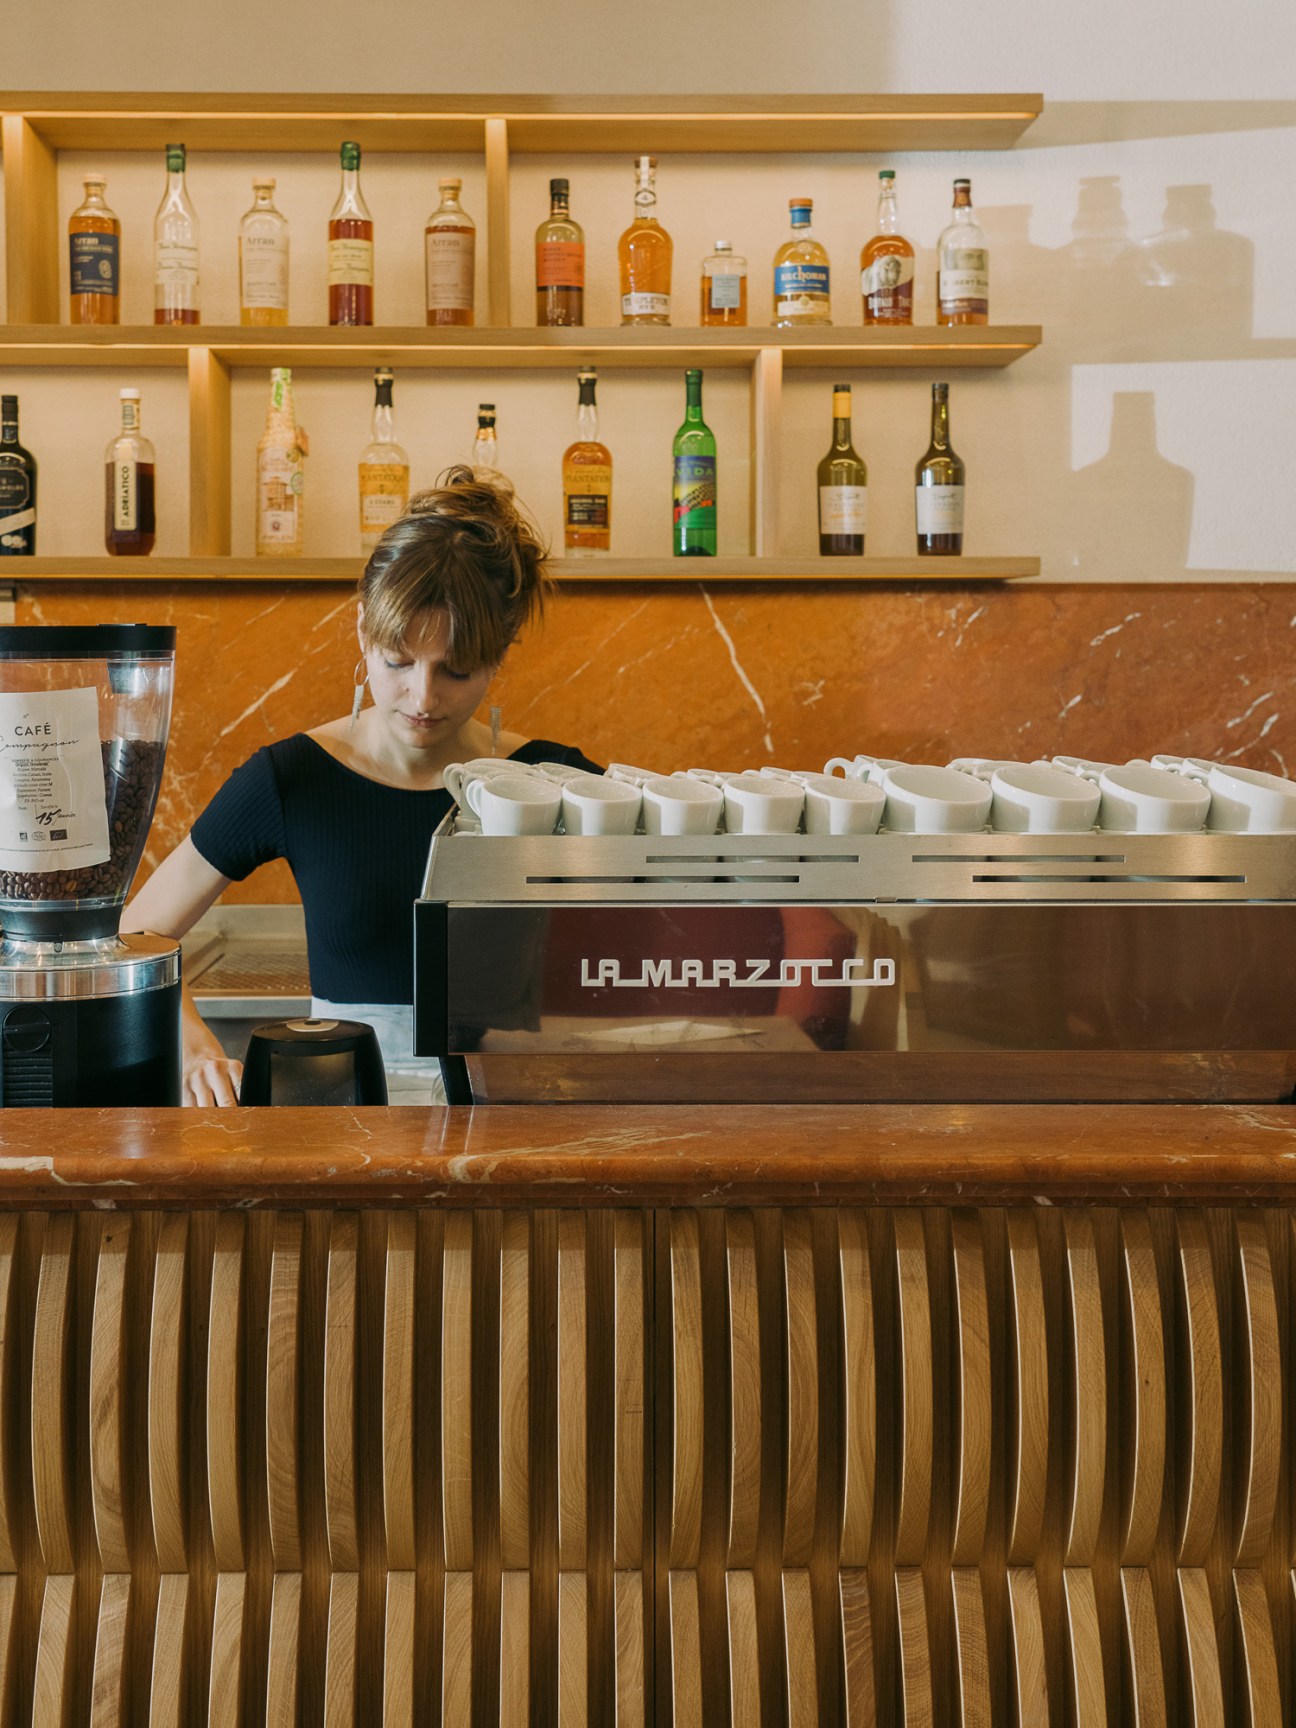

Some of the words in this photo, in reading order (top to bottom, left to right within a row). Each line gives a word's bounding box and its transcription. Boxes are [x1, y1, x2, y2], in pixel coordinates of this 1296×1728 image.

[677, 467, 713, 476] VIDA
[14, 722, 52, 736] CAFÉ
[35, 808, 62, 825] 15
[581, 959, 620, 987] LA
